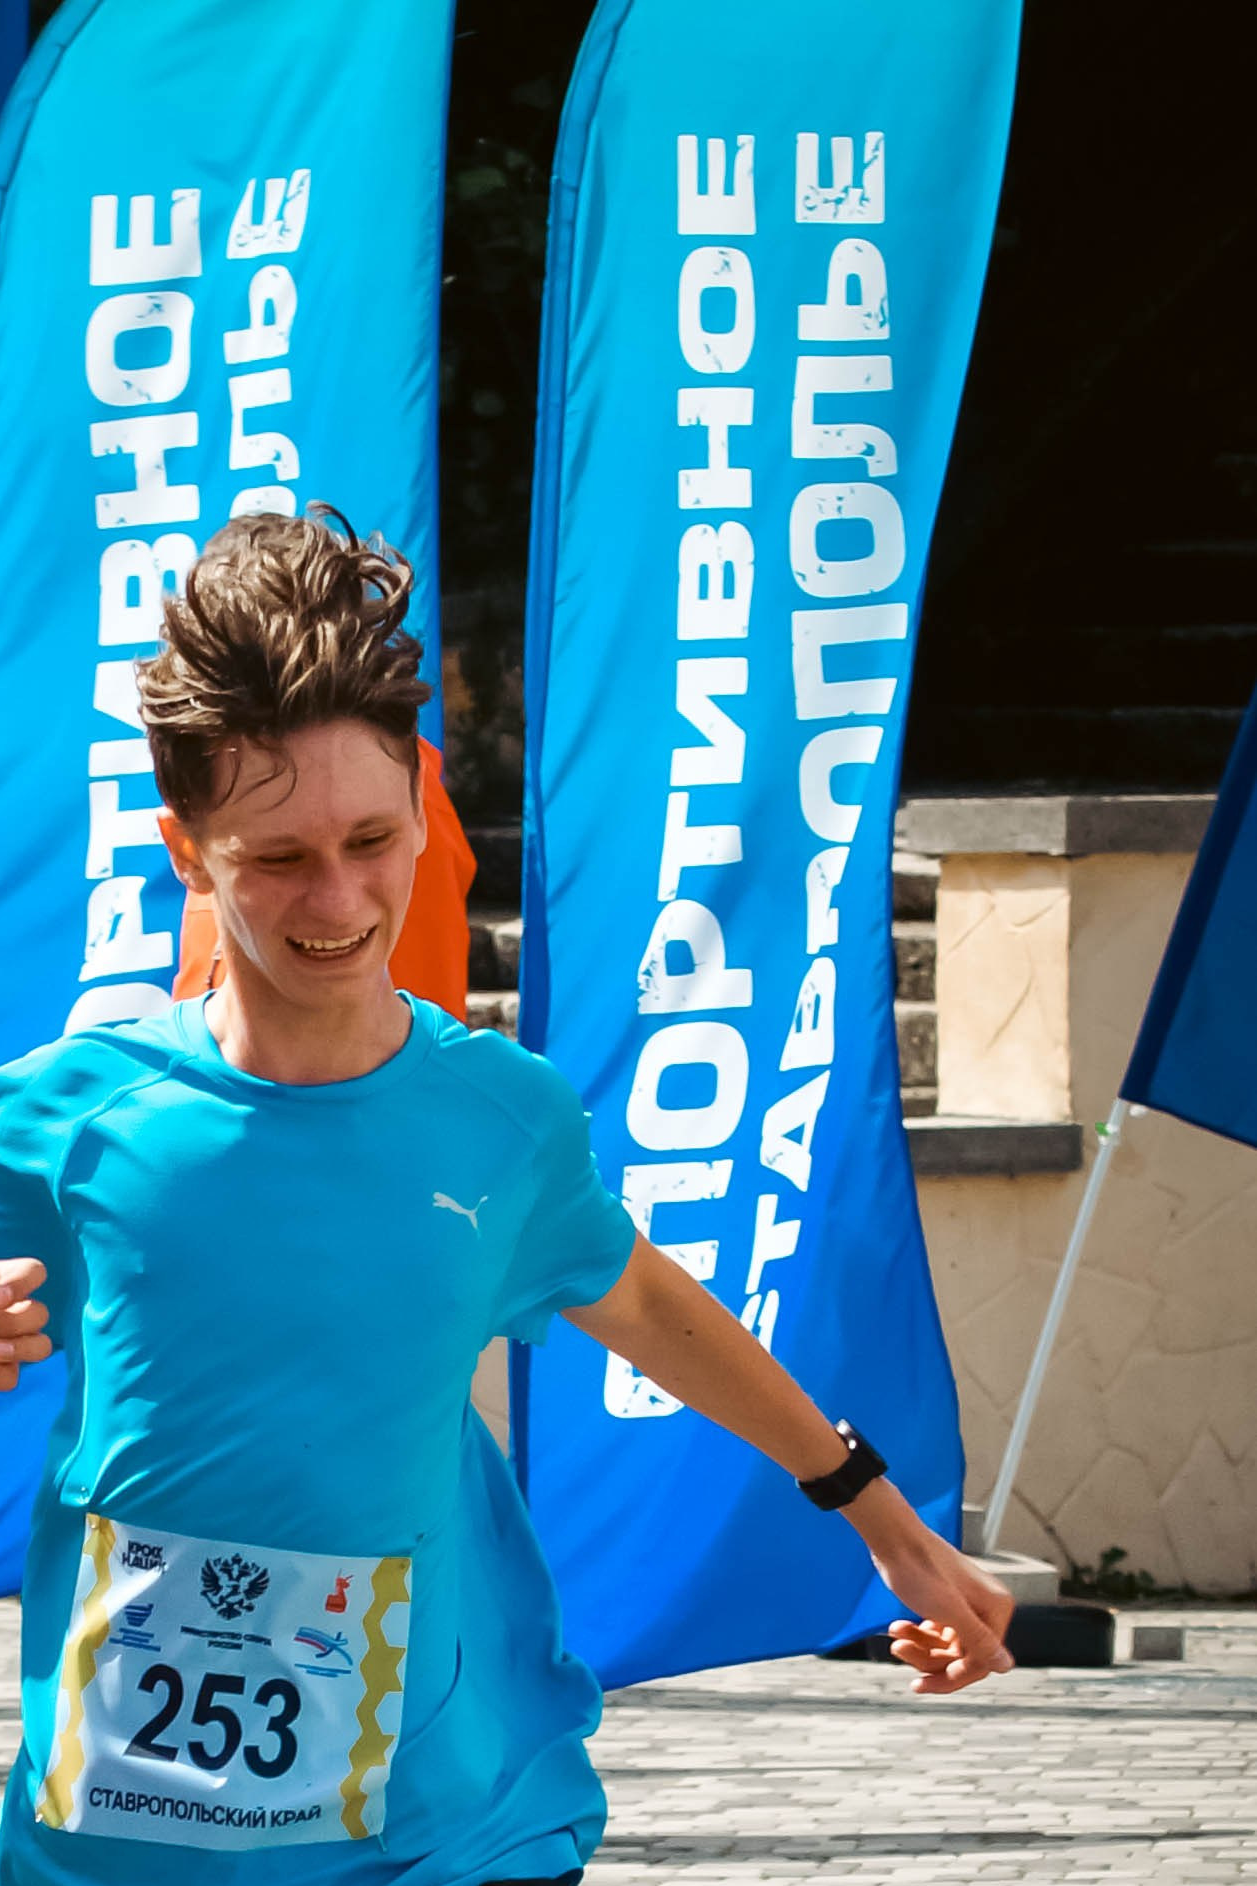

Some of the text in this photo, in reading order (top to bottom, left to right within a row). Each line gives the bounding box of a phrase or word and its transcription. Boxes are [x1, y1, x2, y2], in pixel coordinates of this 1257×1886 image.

[62, 187, 202, 1037] РТИВНОЕ
[122, 1663, 302, 1780] 253
[88, 1786, 322, 1829] СТАВРОПОЛЬСКИЙ КРАЙ
